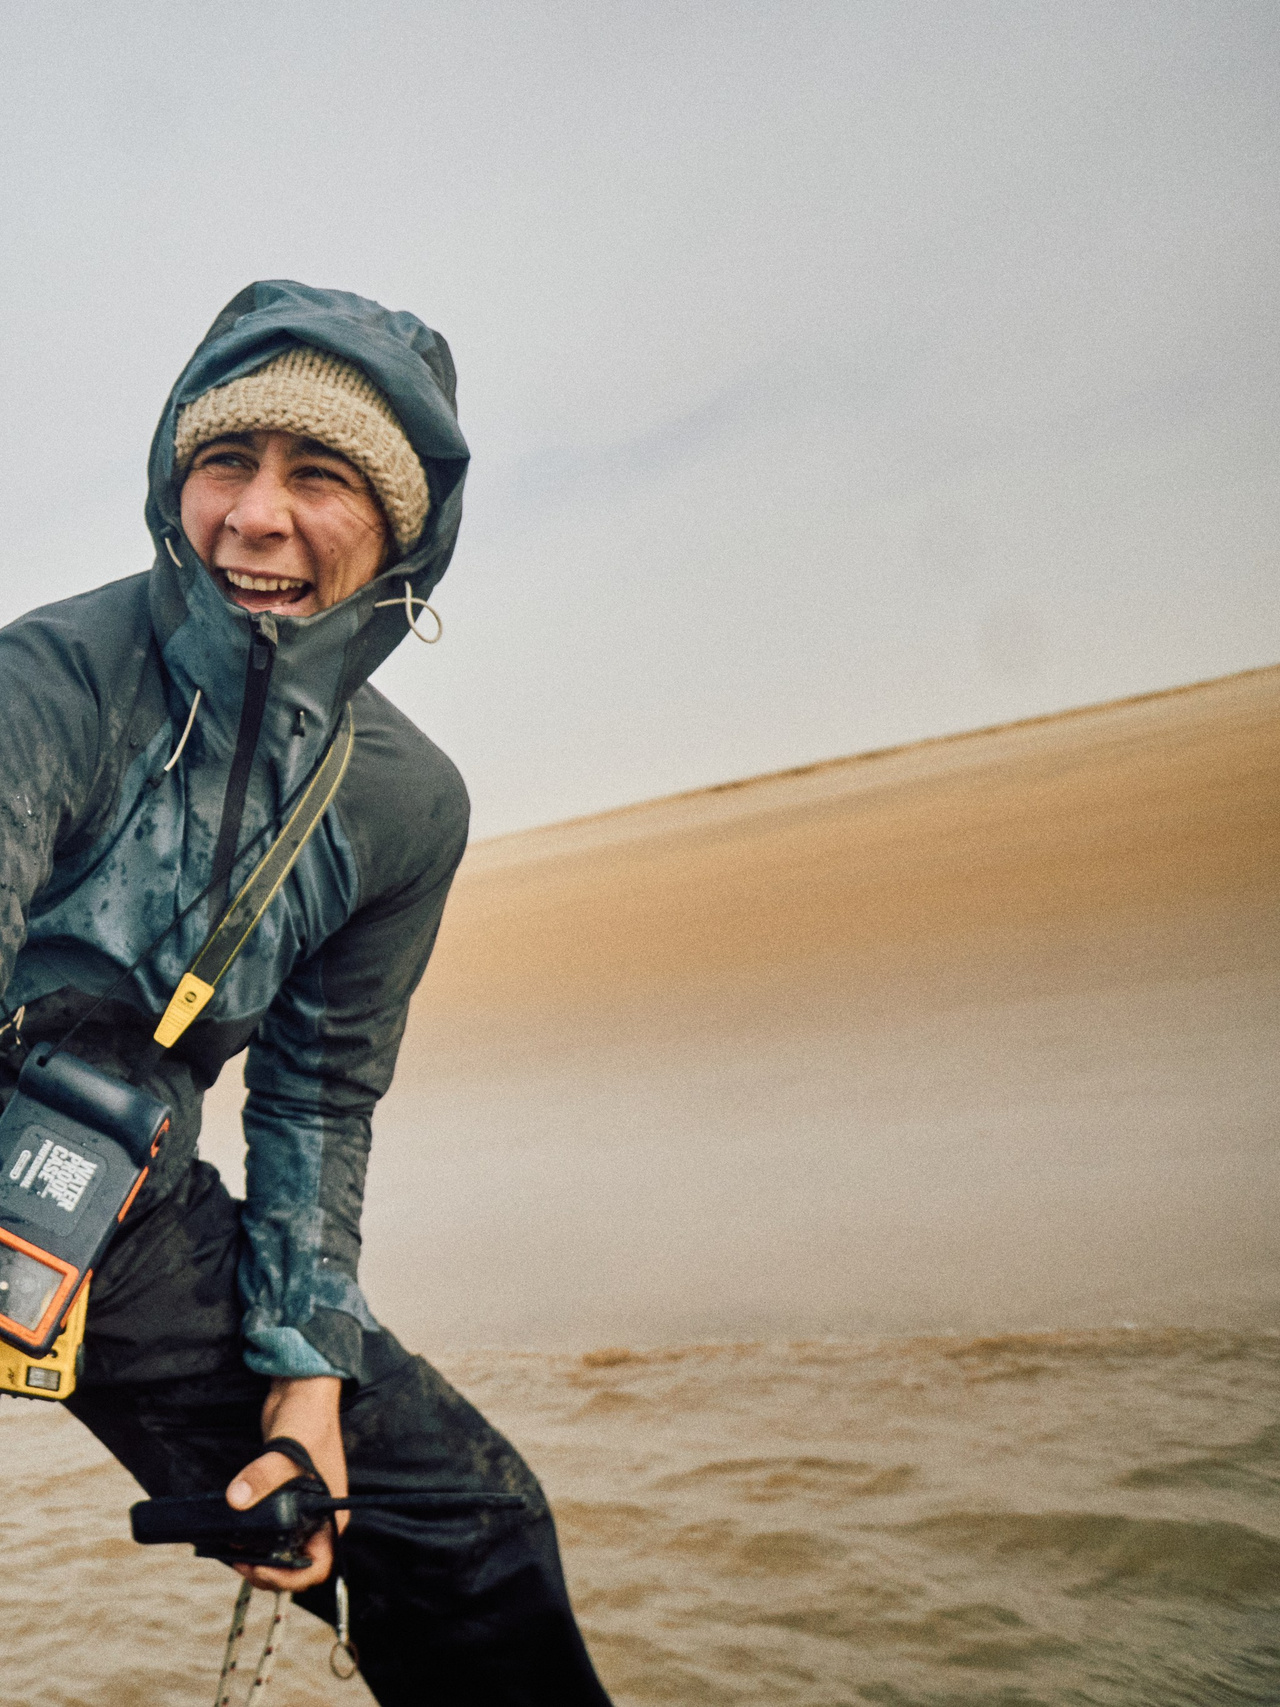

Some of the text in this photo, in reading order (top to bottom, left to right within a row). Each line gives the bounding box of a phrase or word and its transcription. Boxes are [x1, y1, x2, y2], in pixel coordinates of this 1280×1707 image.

[37, 1143, 70, 1183] CASE
[47, 1150, 83, 1201] PROOF
[55, 1158, 98, 1213] WATER
